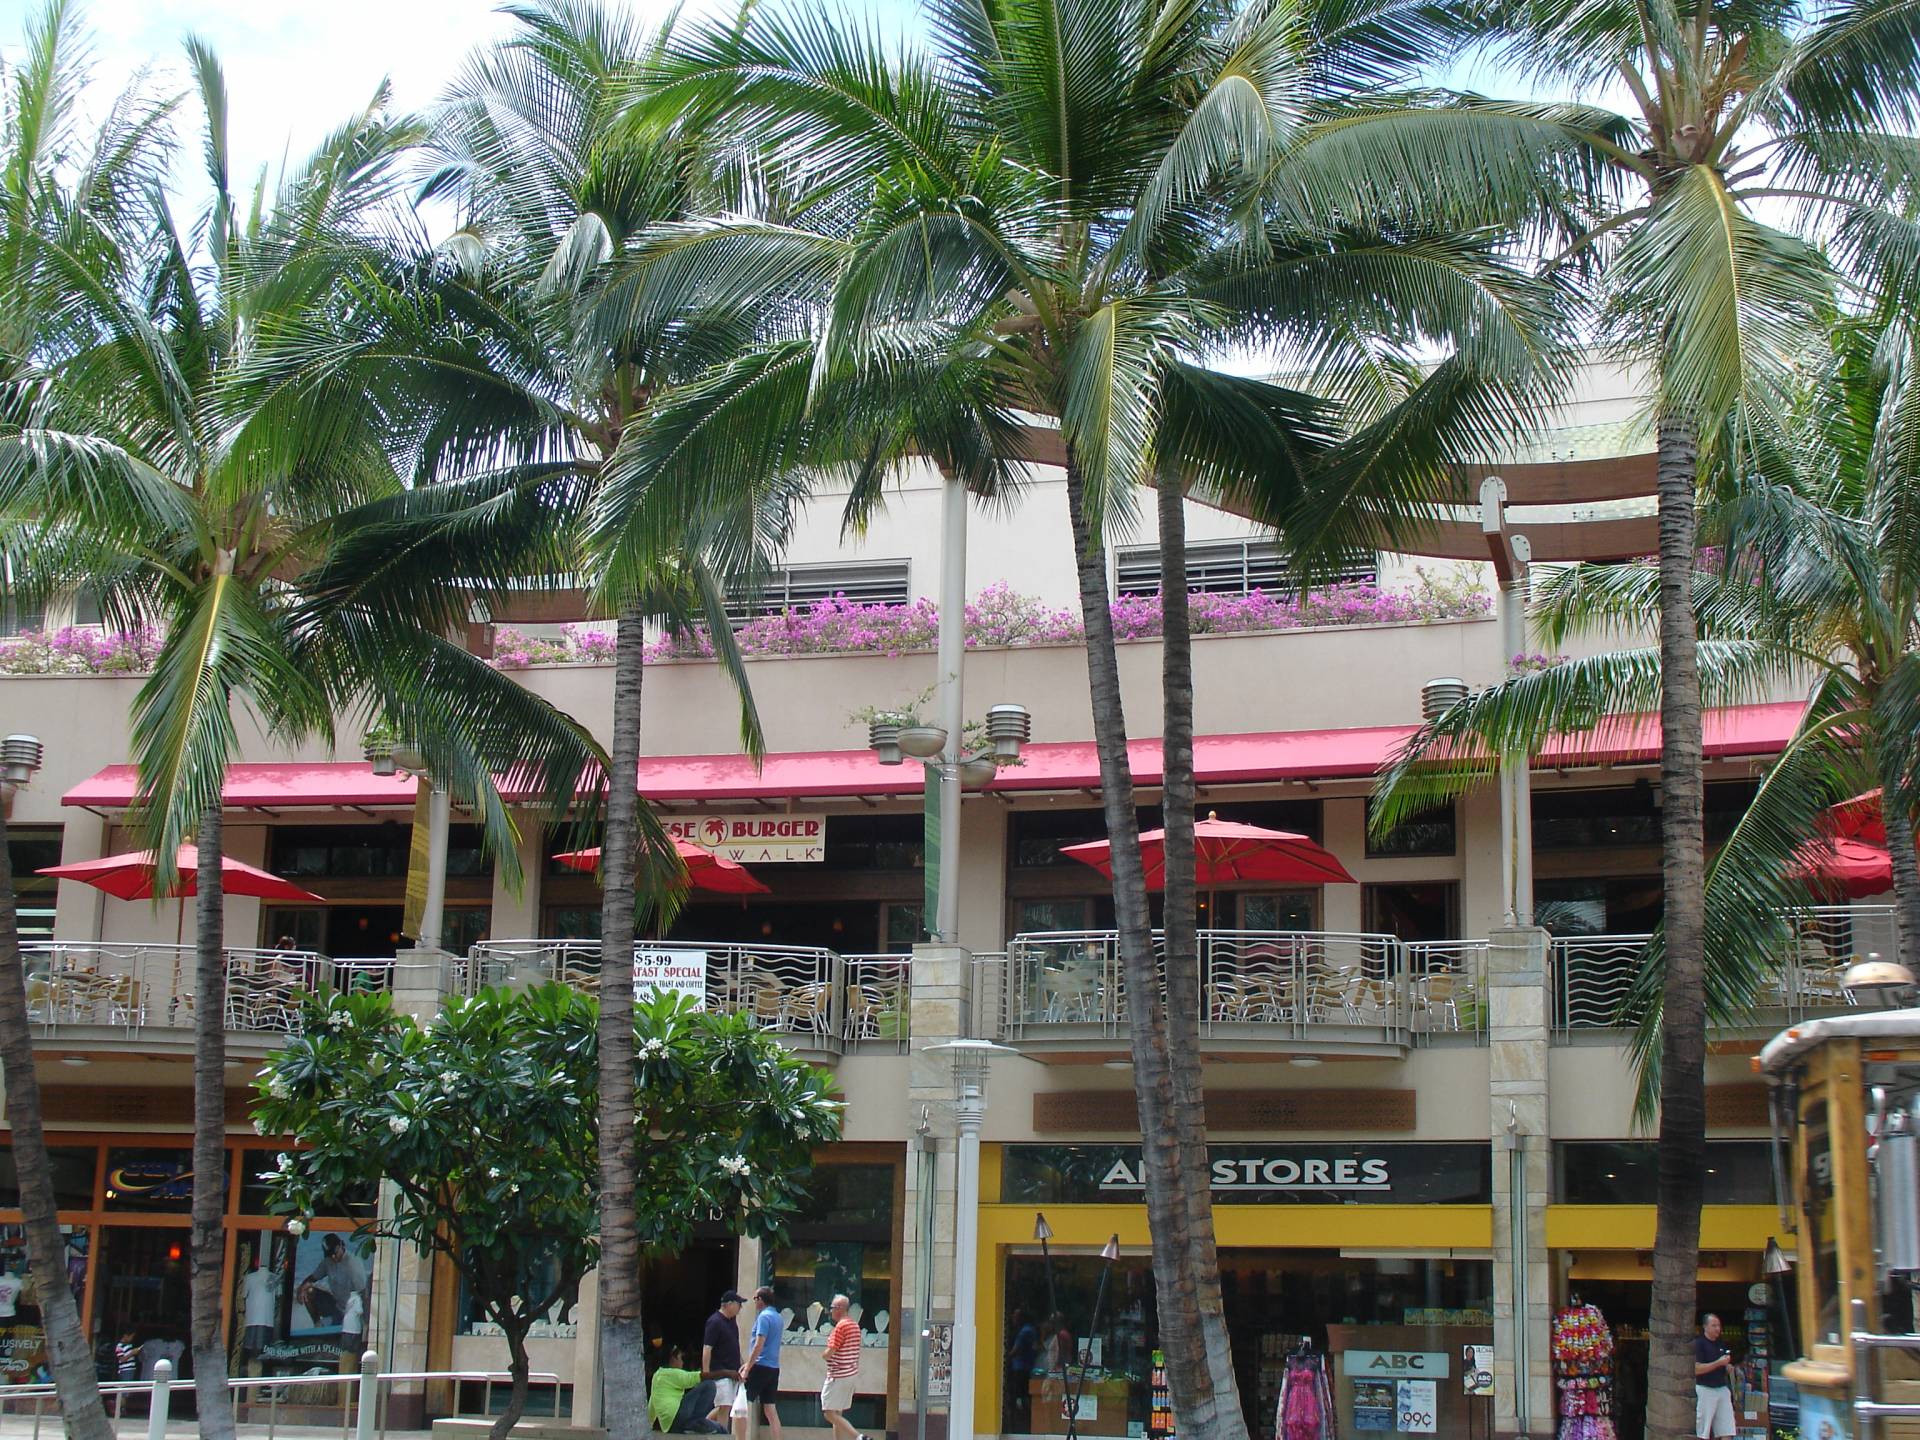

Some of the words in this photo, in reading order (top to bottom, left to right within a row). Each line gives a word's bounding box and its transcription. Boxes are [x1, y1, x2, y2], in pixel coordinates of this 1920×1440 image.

[732, 820, 819, 837] BURGER
[635, 953, 672, 966] $5.99
[663, 967, 702, 977] SPECIAL
[1212, 1159, 1389, 1184] STORES
[1369, 1355, 1424, 1369] ABC
